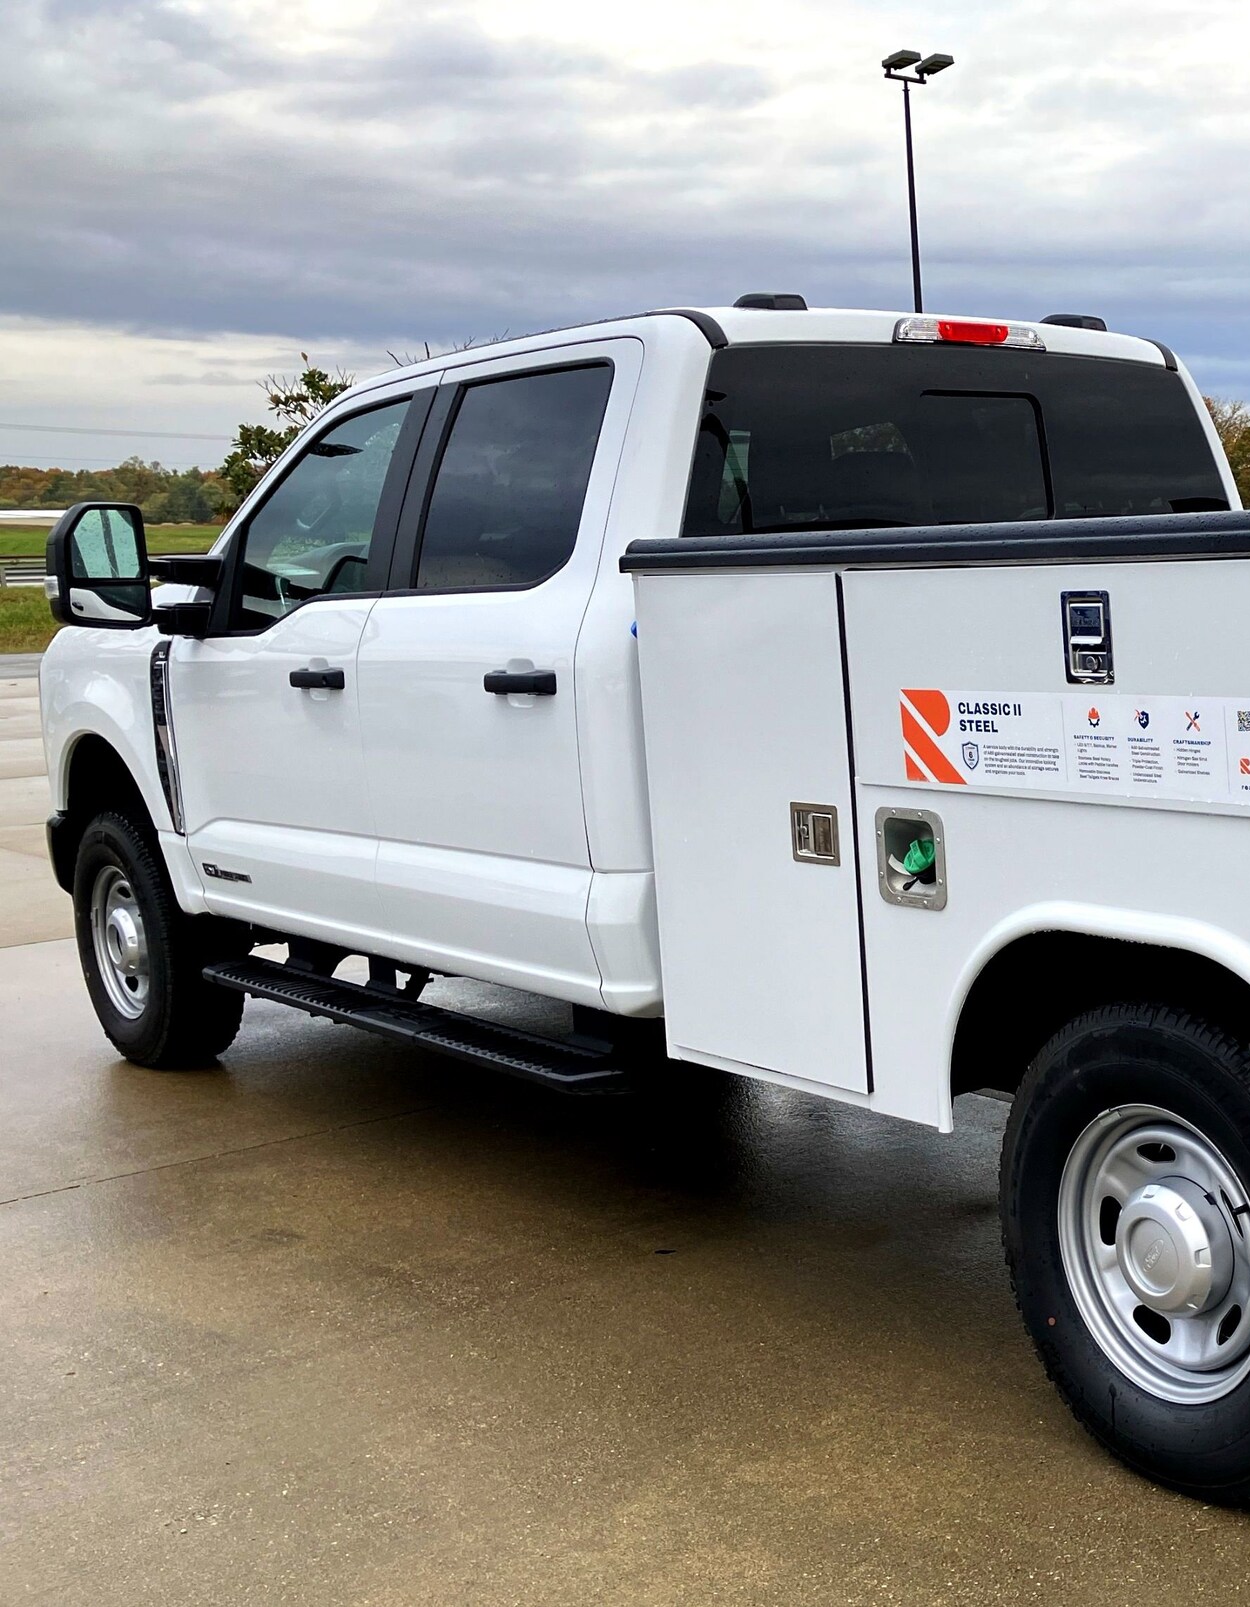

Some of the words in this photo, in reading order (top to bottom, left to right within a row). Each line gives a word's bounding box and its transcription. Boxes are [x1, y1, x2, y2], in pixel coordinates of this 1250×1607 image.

[958, 702, 1011, 715] CLASSIC
[1013, 704, 1021, 716] II
[960, 720, 998, 733] STEEL
